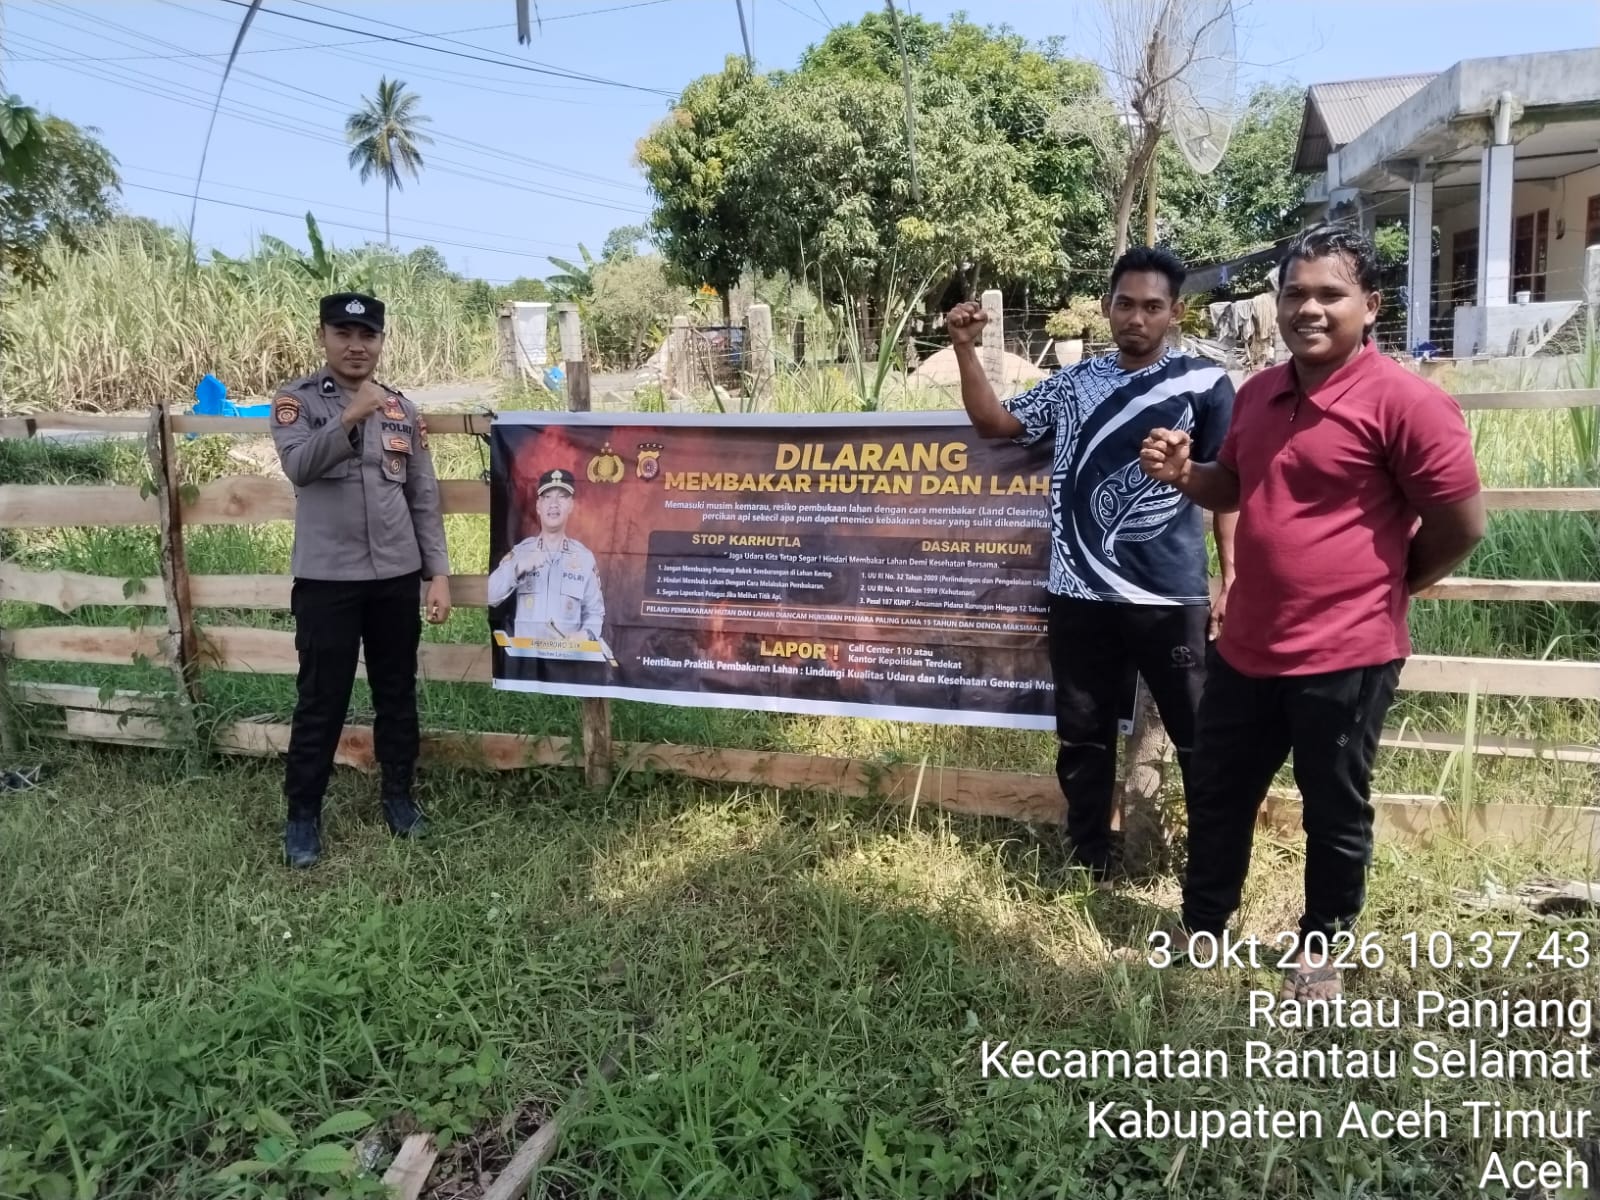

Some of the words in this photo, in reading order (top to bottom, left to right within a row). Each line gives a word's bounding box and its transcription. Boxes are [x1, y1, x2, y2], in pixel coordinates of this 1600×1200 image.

[381, 422, 412, 435] POLRI
[775, 442, 968, 472] DILARANG
[664, 471, 811, 492] MEMBAKAR
[818, 474, 913, 494] HUTAN
[920, 475, 983, 496] DAN
[990, 475, 1050, 496] LAH
[665, 500, 704, 510] Memasuki
[706, 502, 732, 510] musim
[735, 502, 771, 512] kemarau,
[773, 503, 797, 512] resiko
[799, 504, 846, 514] pembukaan
[849, 504, 872, 513] lahan
[874, 505, 906, 515] dengan
[929, 506, 975, 515] membakar
[979, 506, 1003, 516] (Land
[1006, 507, 1048, 518] Clearing)
[702, 512, 736, 522] percikan
[738, 513, 750, 522] api
[752, 513, 778, 522] sekecil
[780, 515, 794, 523] apa
[796, 515, 812, 524] pun
[815, 515, 838, 524] dapat
[840, 516, 874, 524] memicu
[876, 516, 920, 525] kebakaran
[923, 518, 946, 526] besar
[948, 519, 970, 528] yang
[972, 518, 992, 527] sulit
[692, 534, 725, 545] STOP
[729, 534, 801, 548] KARHUTLA
[922, 540, 970, 553] DASAR
[975, 542, 1032, 555] HUKUM
[728, 552, 743, 561] Jaga
[745, 552, 764, 560] Udara
[766, 553, 778, 561] Kita
[780, 554, 797, 562] Tetap
[799, 554, 817, 564] Segar
[823, 555, 848, 564] Hindari
[850, 556, 885, 564] Membakar
[887, 557, 908, 565] Lahan
[910, 558, 927, 566] Demi
[929, 558, 965, 568] Kesehatan
[968, 560, 1000, 569] Bersama.
[562, 572, 584, 581] POLRI
[646, 605, 670, 613] PELAKU
[671, 606, 714, 615] PEMBAKARAN
[714, 608, 736, 616] HUTAN
[738, 609, 752, 617] DAN
[753, 610, 775, 618] LAHAN
[776, 611, 807, 620] DIANCAM
[808, 613, 842, 622] HUKUMAN
[844, 614, 874, 623] PENJARA
[876, 616, 900, 624] PALING
[901, 617, 922, 626] LAMA
[933, 618, 957, 627] TAHUN
[959, 620, 974, 628] DAN
[976, 622, 1000, 630] DENDA
[1003, 623, 1041, 632] MAKSIMAL
[1043, 624, 1048, 632] R
[760, 640, 826, 660] LAPOR
[832, 645, 839, 660] !
[848, 644, 864, 654] Call
[866, 644, 894, 655] Center
[896, 646, 912, 656] 110
[914, 647, 934, 656] atau
[848, 654, 876, 664] Kantor
[878, 656, 922, 667] Kepolisian
[925, 659, 962, 670] Terdekat
[642, 656, 682, 668] Hentikan
[684, 660, 714, 670] Praktik
[717, 661, 770, 673] Pembakaran
[772, 664, 798, 675] Lahan
[806, 666, 845, 680] Lindungi
[848, 670, 884, 680] Kualitas
[887, 672, 915, 682] Udara
[917, 673, 936, 684] dan
[938, 674, 988, 687] Kesehatan
[990, 677, 1032, 690] Generasi
